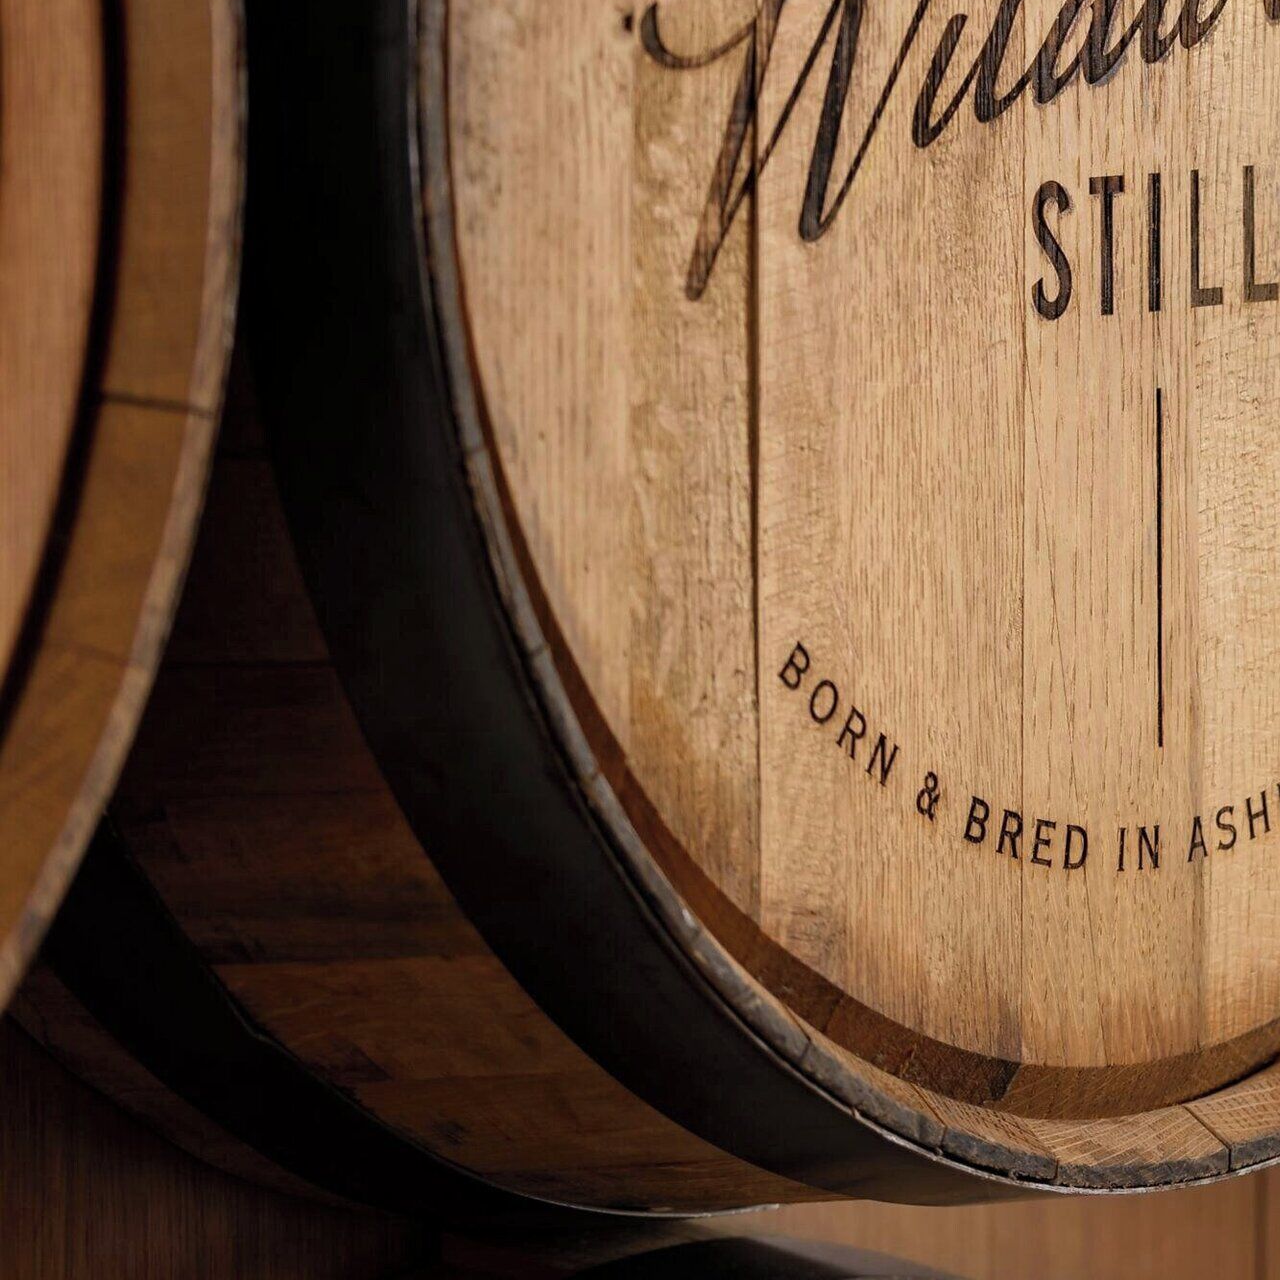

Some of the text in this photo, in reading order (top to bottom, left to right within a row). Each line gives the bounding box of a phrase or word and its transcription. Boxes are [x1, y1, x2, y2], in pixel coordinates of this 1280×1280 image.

[1031, 164, 1280, 322] STILL
[777, 641, 901, 786] BORN
[915, 771, 942, 821] &
[962, 795, 1090, 872] BRED
[1116, 824, 1162, 872] IN
